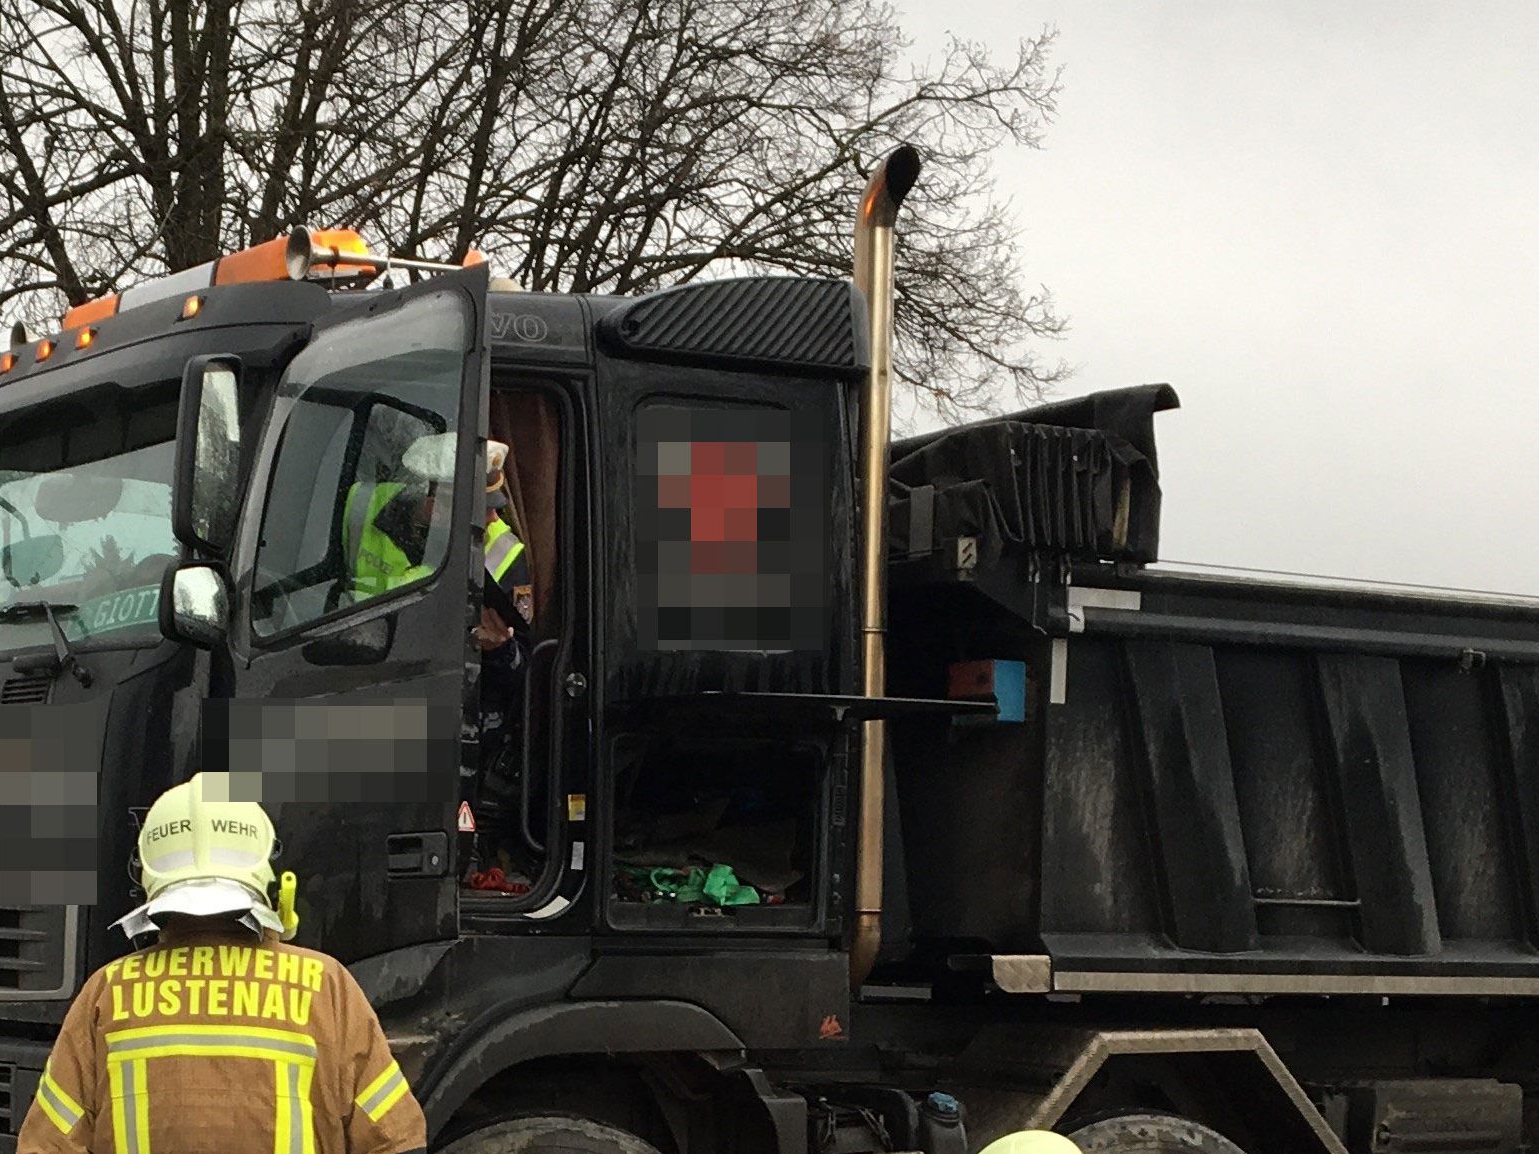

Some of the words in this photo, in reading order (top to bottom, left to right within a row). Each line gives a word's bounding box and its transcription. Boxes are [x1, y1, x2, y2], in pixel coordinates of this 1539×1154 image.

[146, 819, 192, 846] FEUER
[211, 819, 259, 840] WEHR
[106, 945, 325, 993] FEUERWEHR
[112, 979, 312, 1027] LUSTENAU
